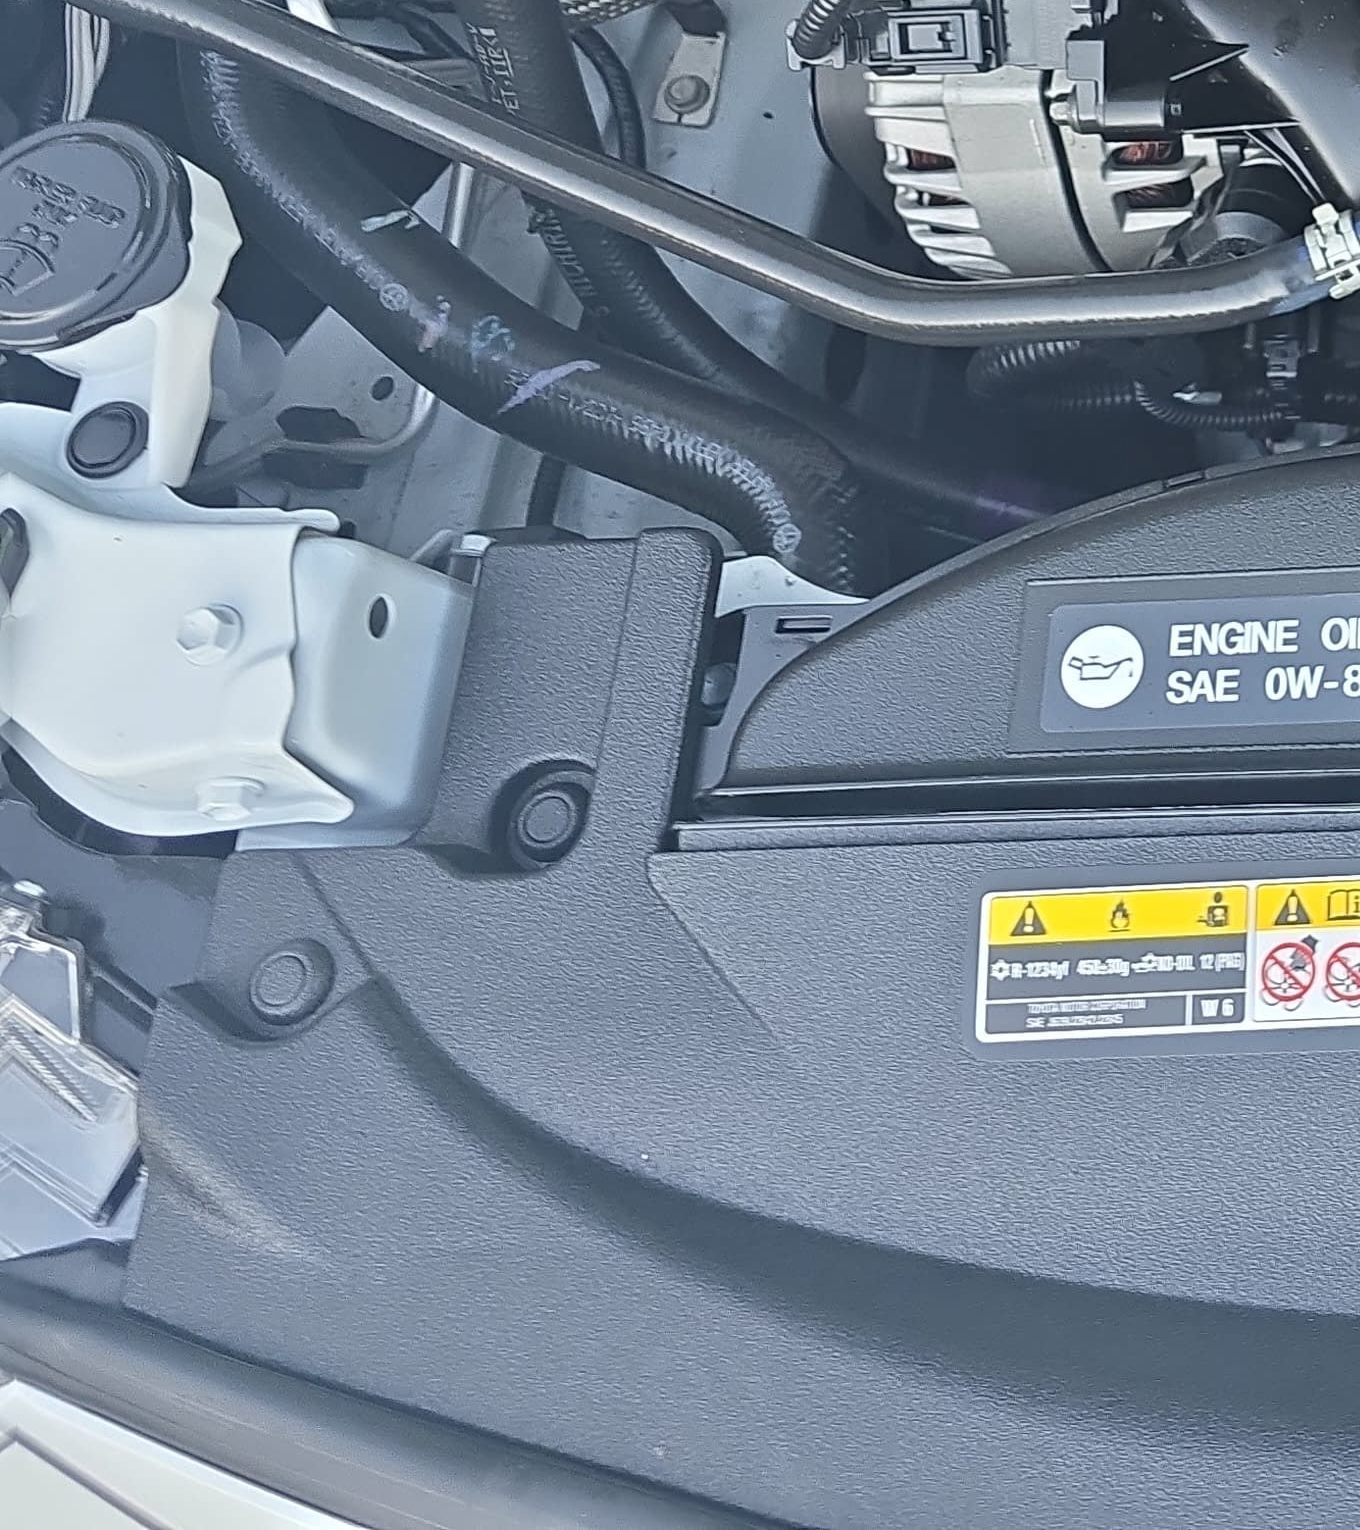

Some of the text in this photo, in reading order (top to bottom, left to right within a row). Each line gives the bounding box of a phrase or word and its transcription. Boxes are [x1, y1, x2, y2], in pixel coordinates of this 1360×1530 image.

[1168, 618, 1300, 657] ENGINE
[1165, 668, 1241, 705] SAE
[1200, 999, 1234, 1018] W 6
